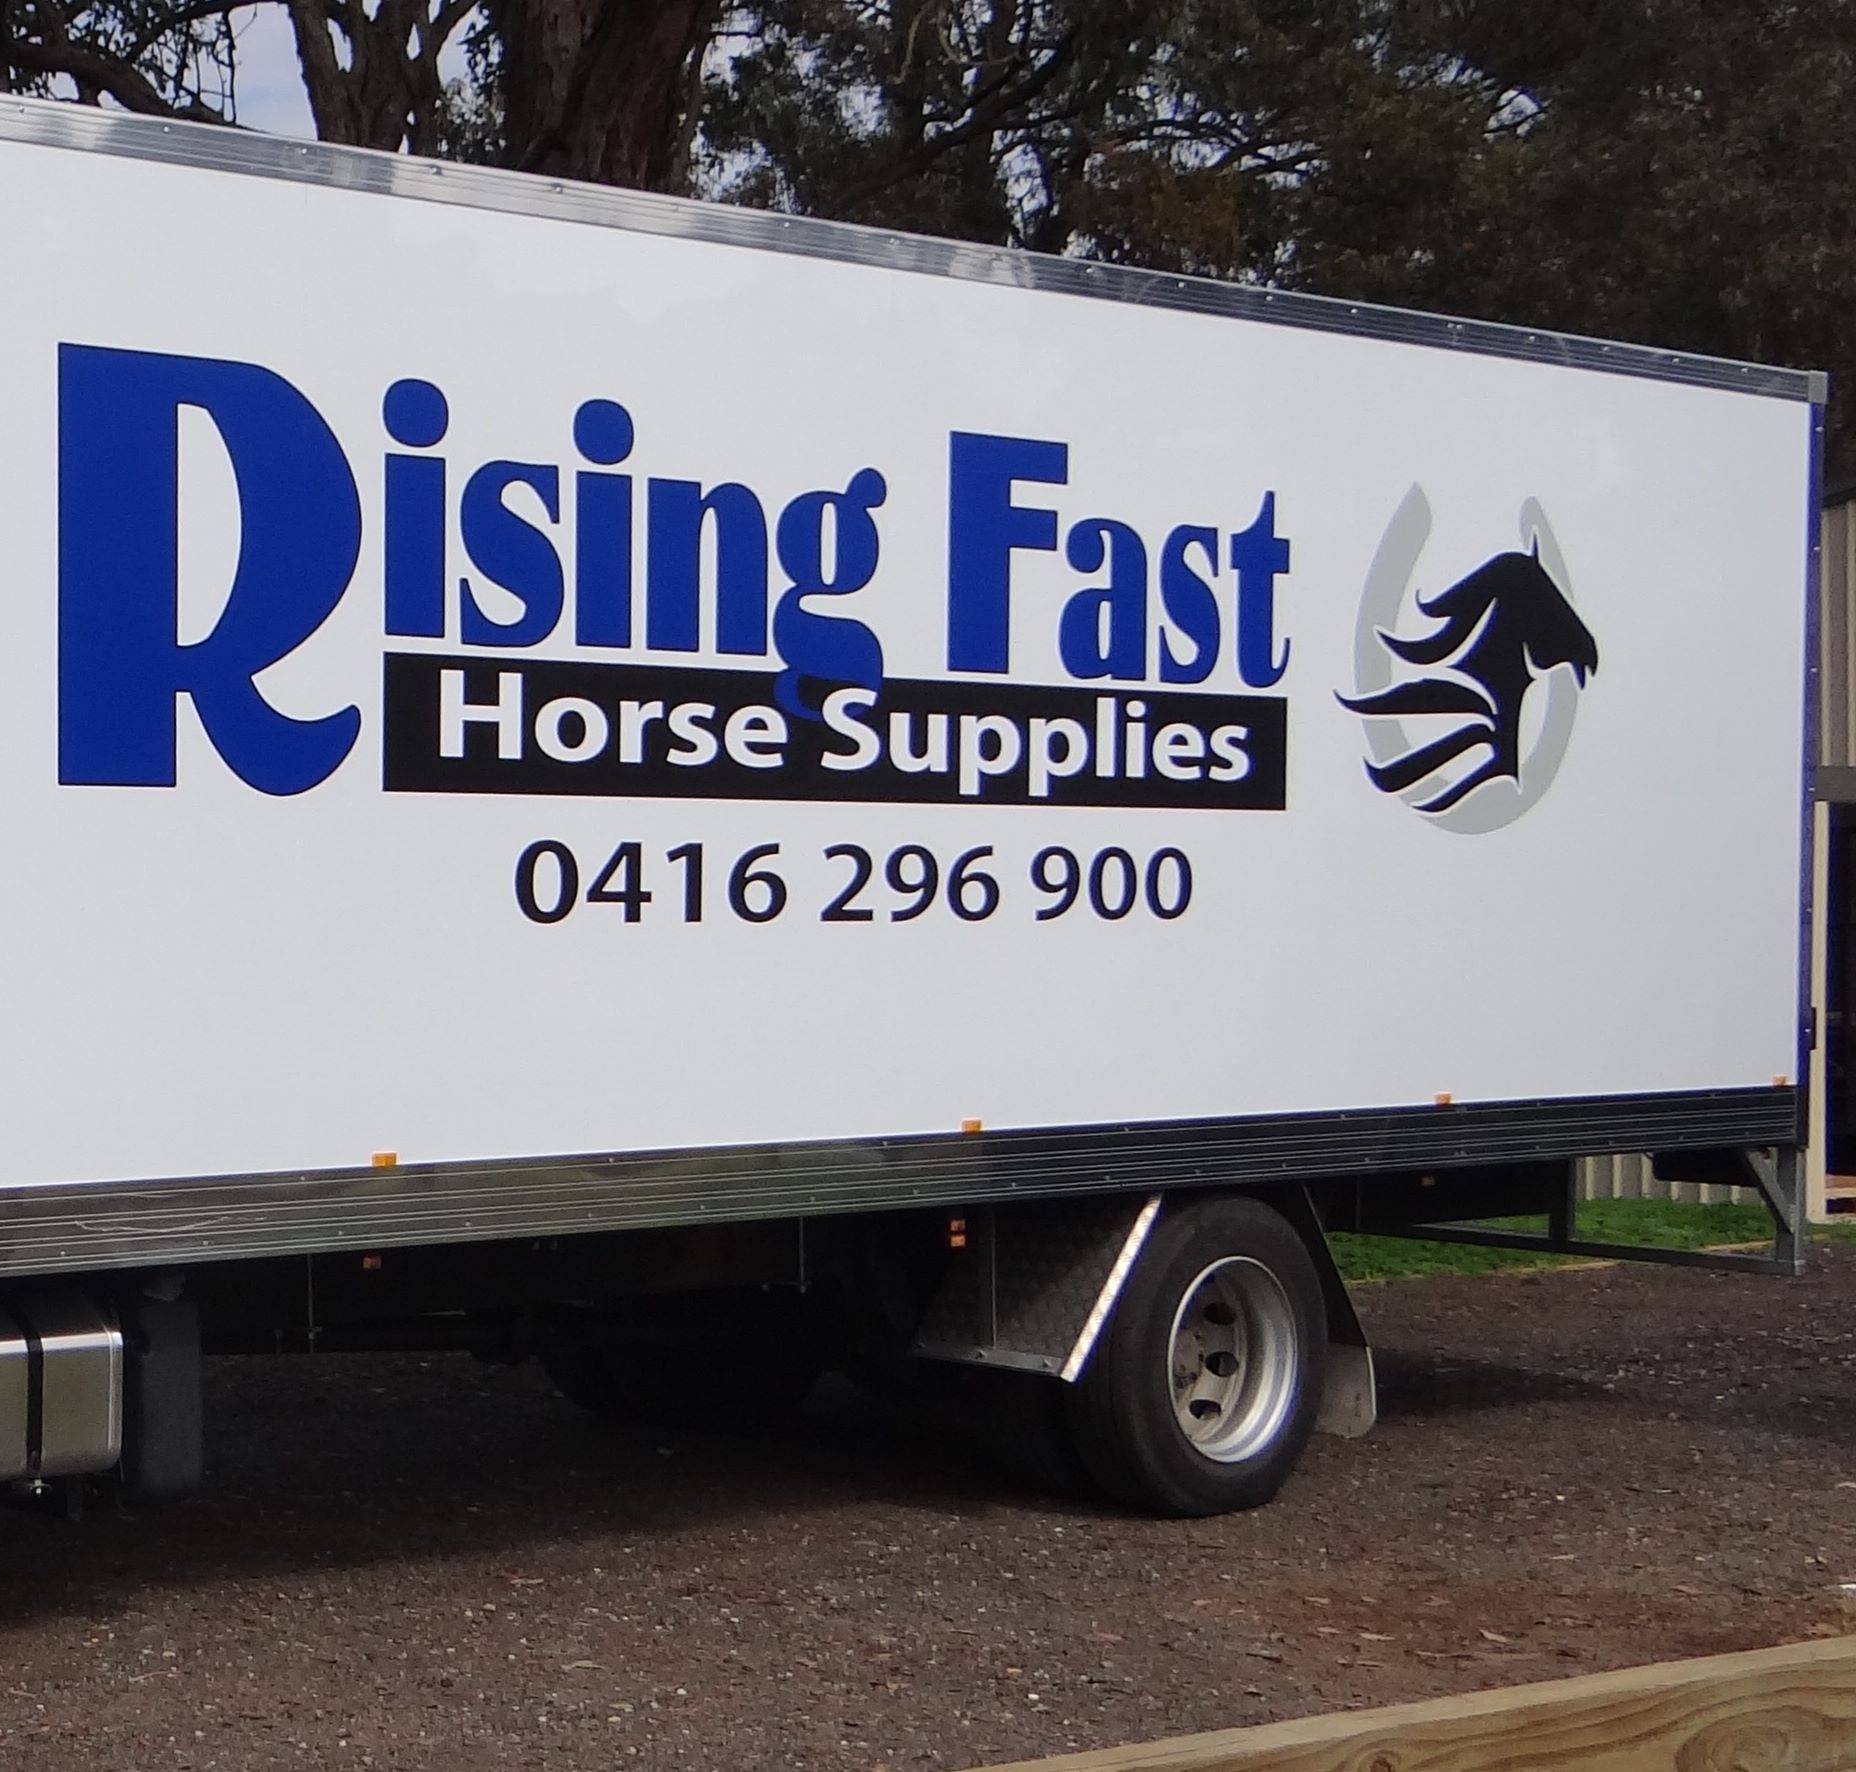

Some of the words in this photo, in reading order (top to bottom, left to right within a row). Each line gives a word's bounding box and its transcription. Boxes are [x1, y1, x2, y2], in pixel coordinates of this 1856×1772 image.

[58, 342, 887, 796] Rising
[947, 431, 1291, 688] Fast
[438, 668, 785, 771] Horse
[819, 686, 1251, 796] Supplies
[514, 839, 789, 924] 0416
[819, 842, 1001, 923] 296
[1031, 844, 1194, 921] 900
